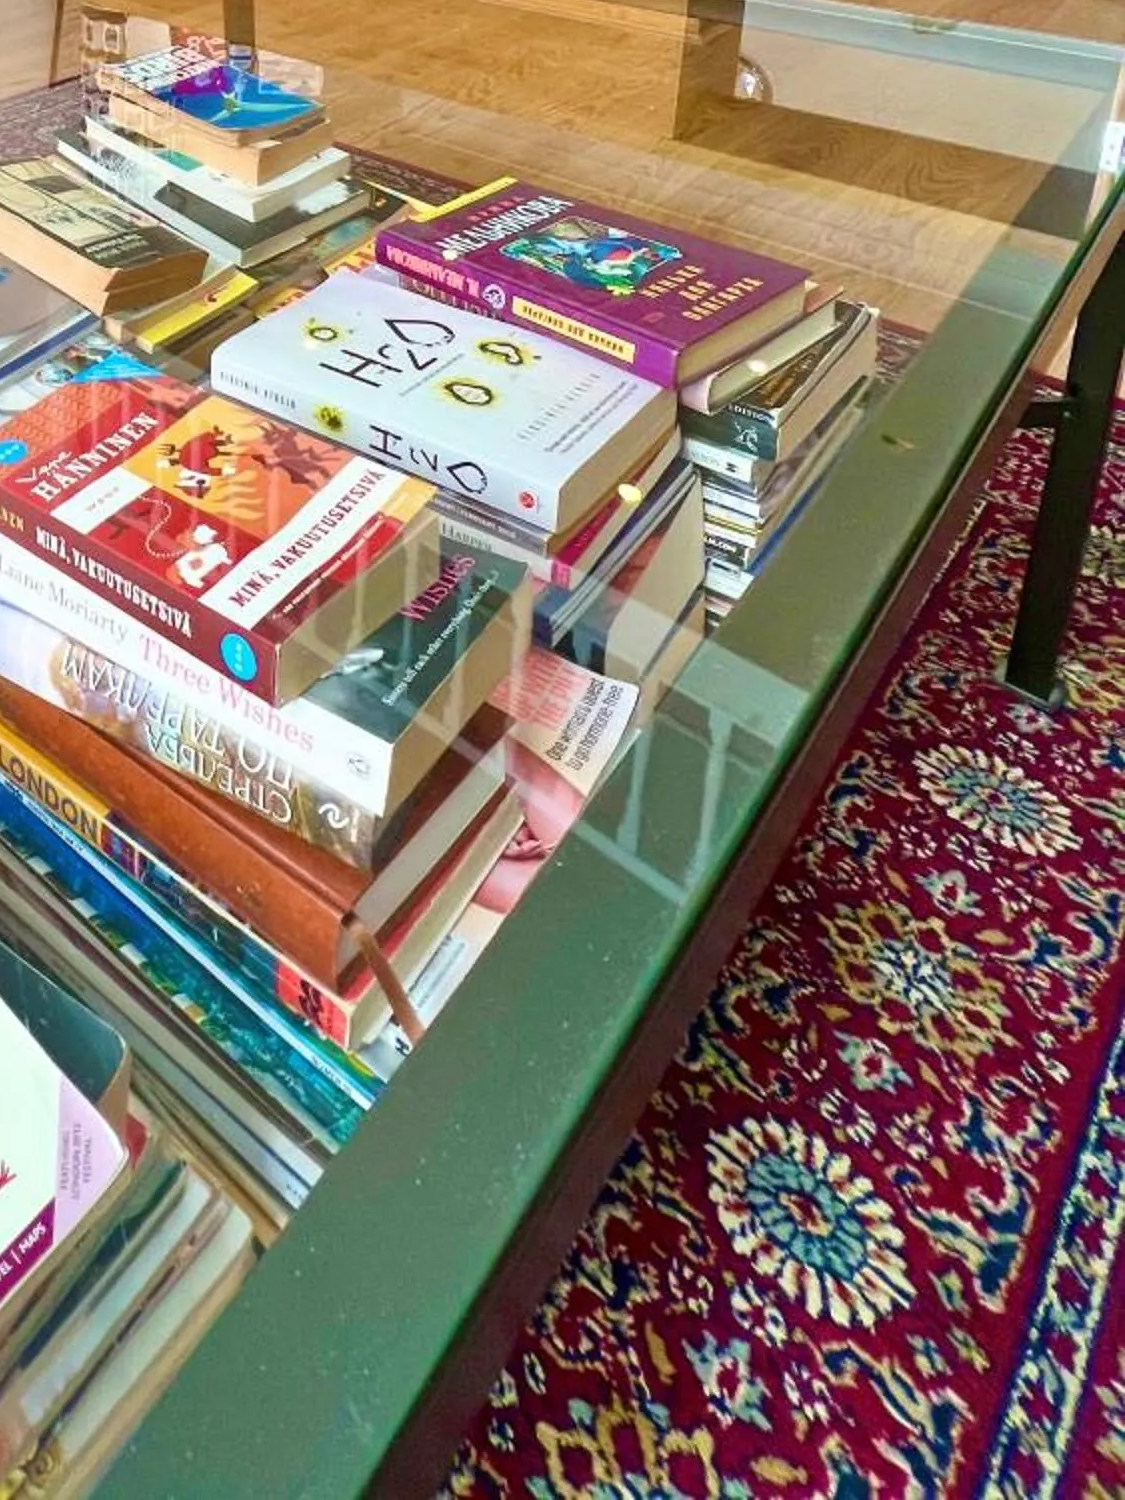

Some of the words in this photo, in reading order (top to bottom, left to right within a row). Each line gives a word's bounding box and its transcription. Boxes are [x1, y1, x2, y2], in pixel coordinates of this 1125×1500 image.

[270, 468, 389, 568] VAKUUTUSETSIVÄ
[73, 548, 193, 640] VAKUUTUSETSIVÄ
[48, 581, 129, 643] Moriarty
[138, 630, 213, 698] Three
[217, 675, 316, 754] Wishes
[60, 643, 225, 756] ТАРЕЛКАМ
[144, 722, 293, 824] СТРЕЛЬБА
[237, 740, 294, 791] ПО
[19, 1221, 48, 1258] MAPS
